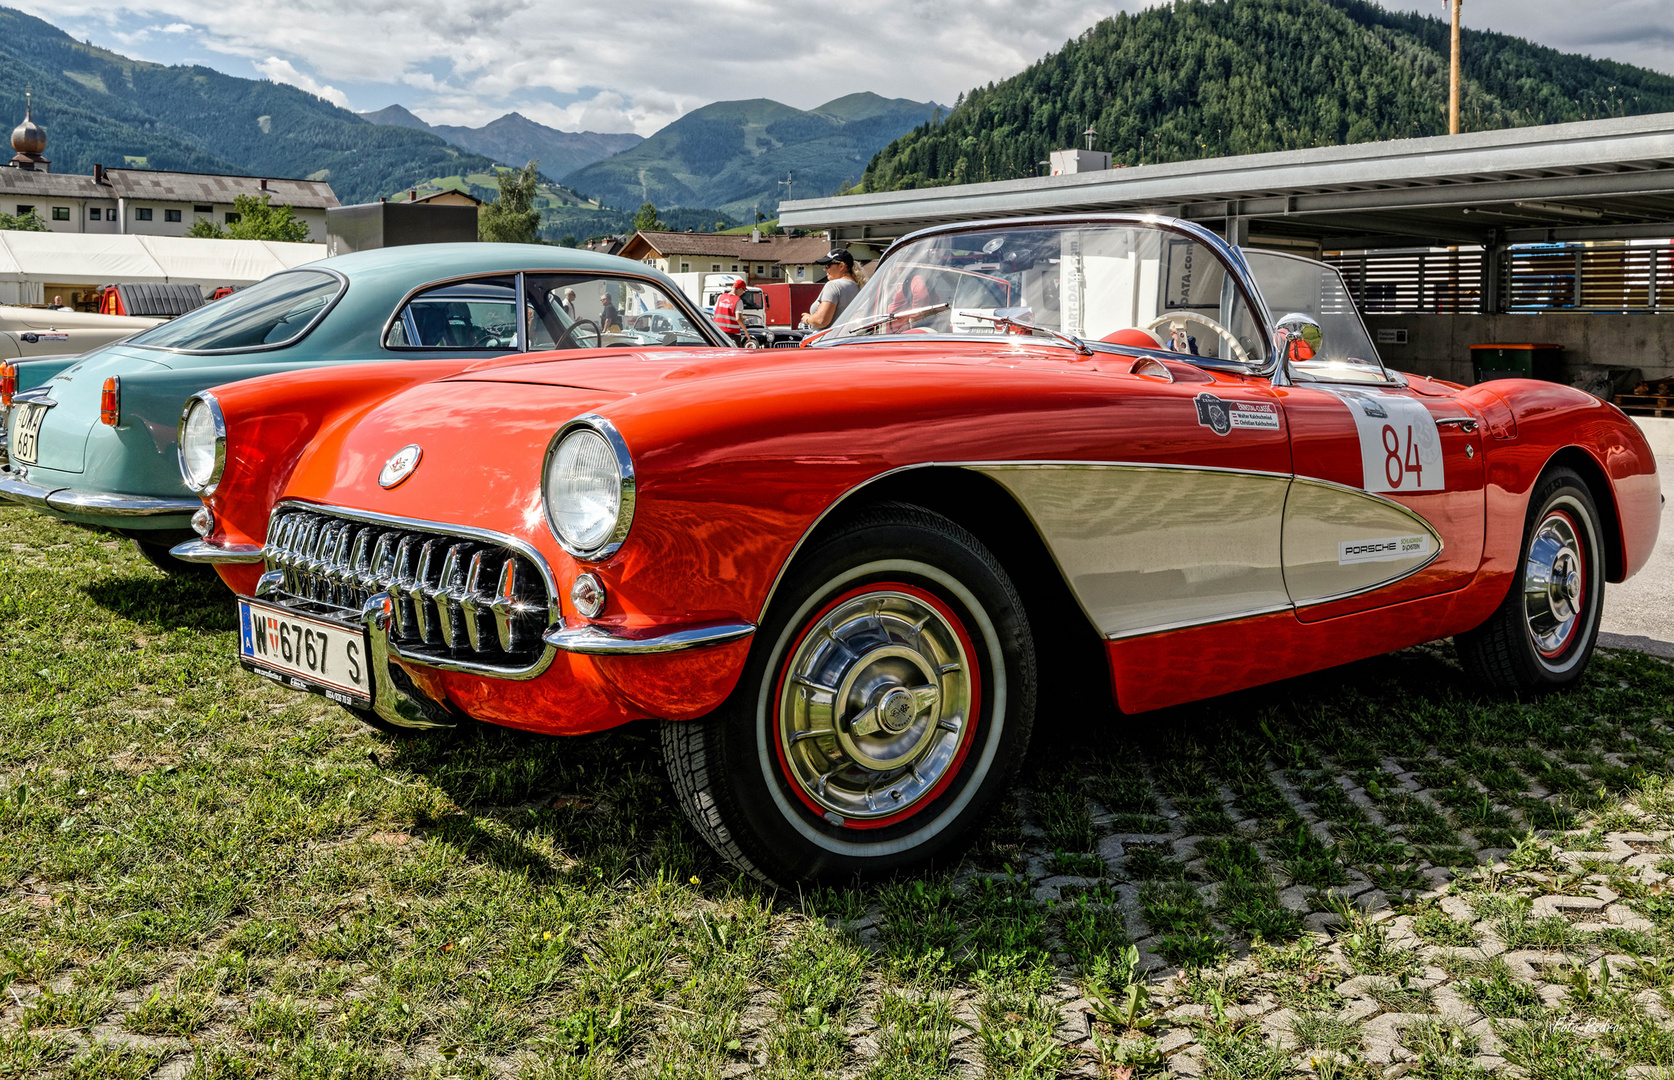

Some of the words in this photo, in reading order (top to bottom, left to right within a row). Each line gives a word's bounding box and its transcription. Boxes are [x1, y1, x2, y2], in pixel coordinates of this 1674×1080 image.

[17, 431, 34, 458] 687
[1382, 424, 1422, 489] 84
[1345, 542, 1397, 555] PORSCHE
[245, 636, 252, 649] A
[253, 613, 267, 656] W
[280, 621, 328, 674] 6767
[346, 639, 360, 685] S
